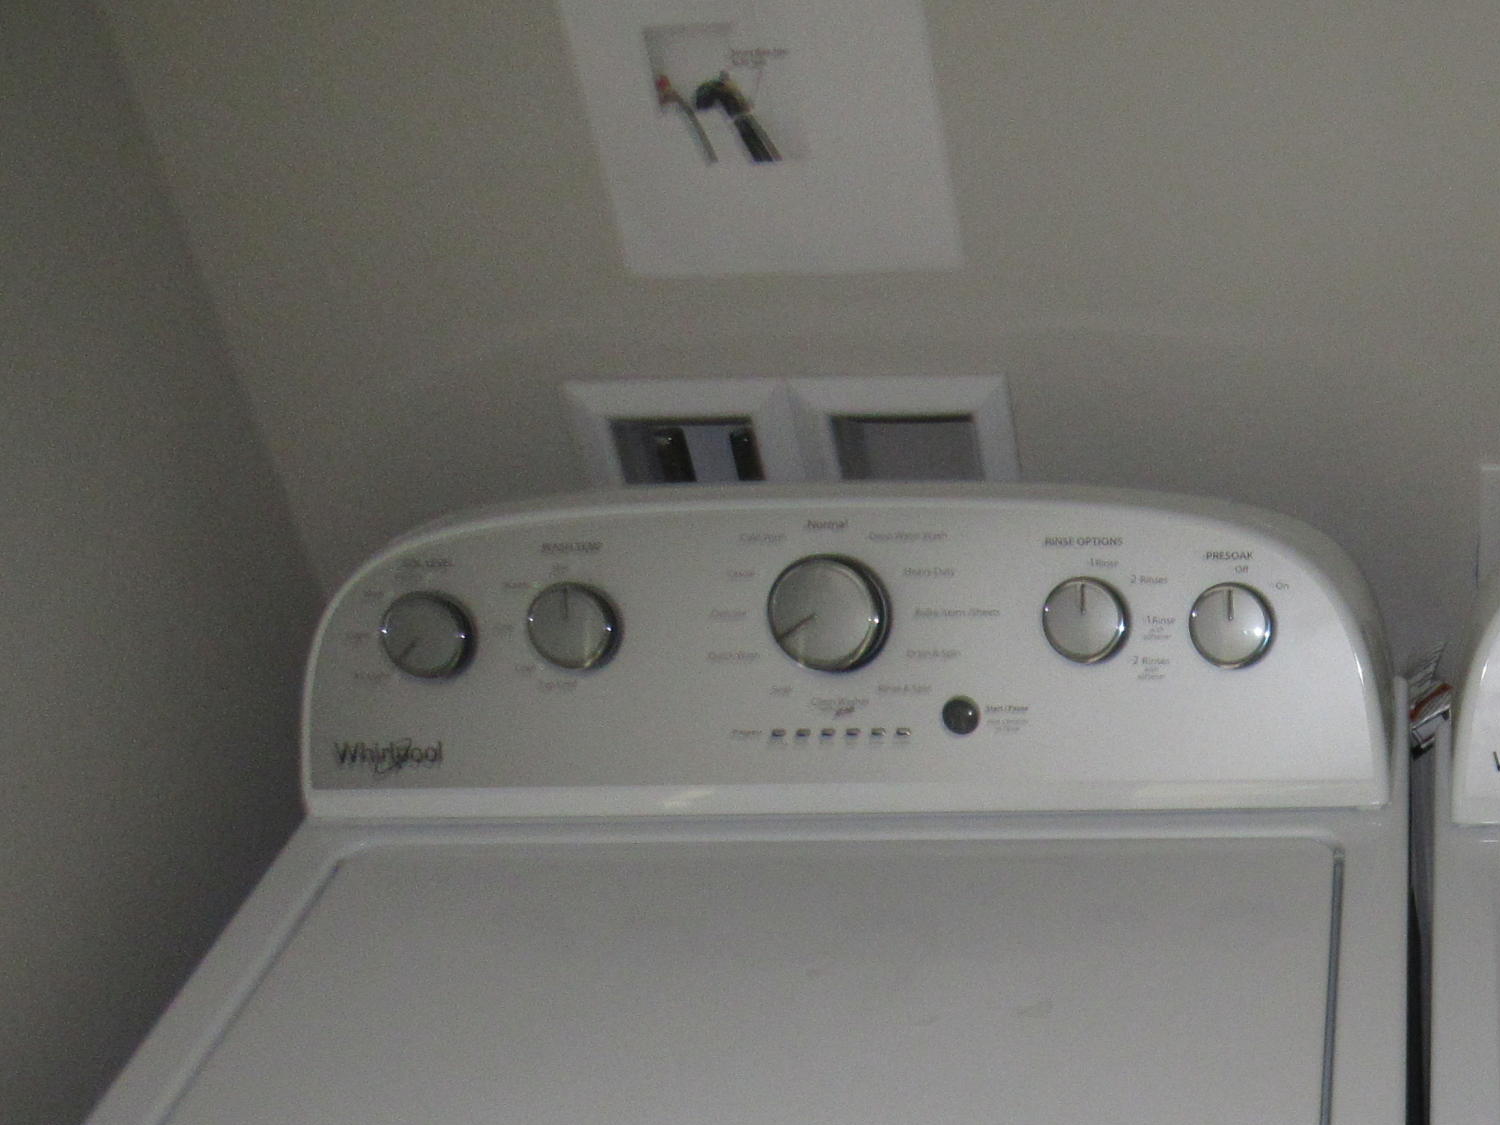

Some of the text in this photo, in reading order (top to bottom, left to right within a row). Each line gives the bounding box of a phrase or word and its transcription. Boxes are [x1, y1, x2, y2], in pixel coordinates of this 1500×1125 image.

[804, 519, 848, 530] Normal
[1044, 536, 1123, 547] RINSE OPTIONS
[1204, 550, 1253, 561] PRESOAK
[1233, 564, 1249, 574] Off
[1275, 580, 1290, 590] On
[334, 739, 443, 777] Whirlpool
